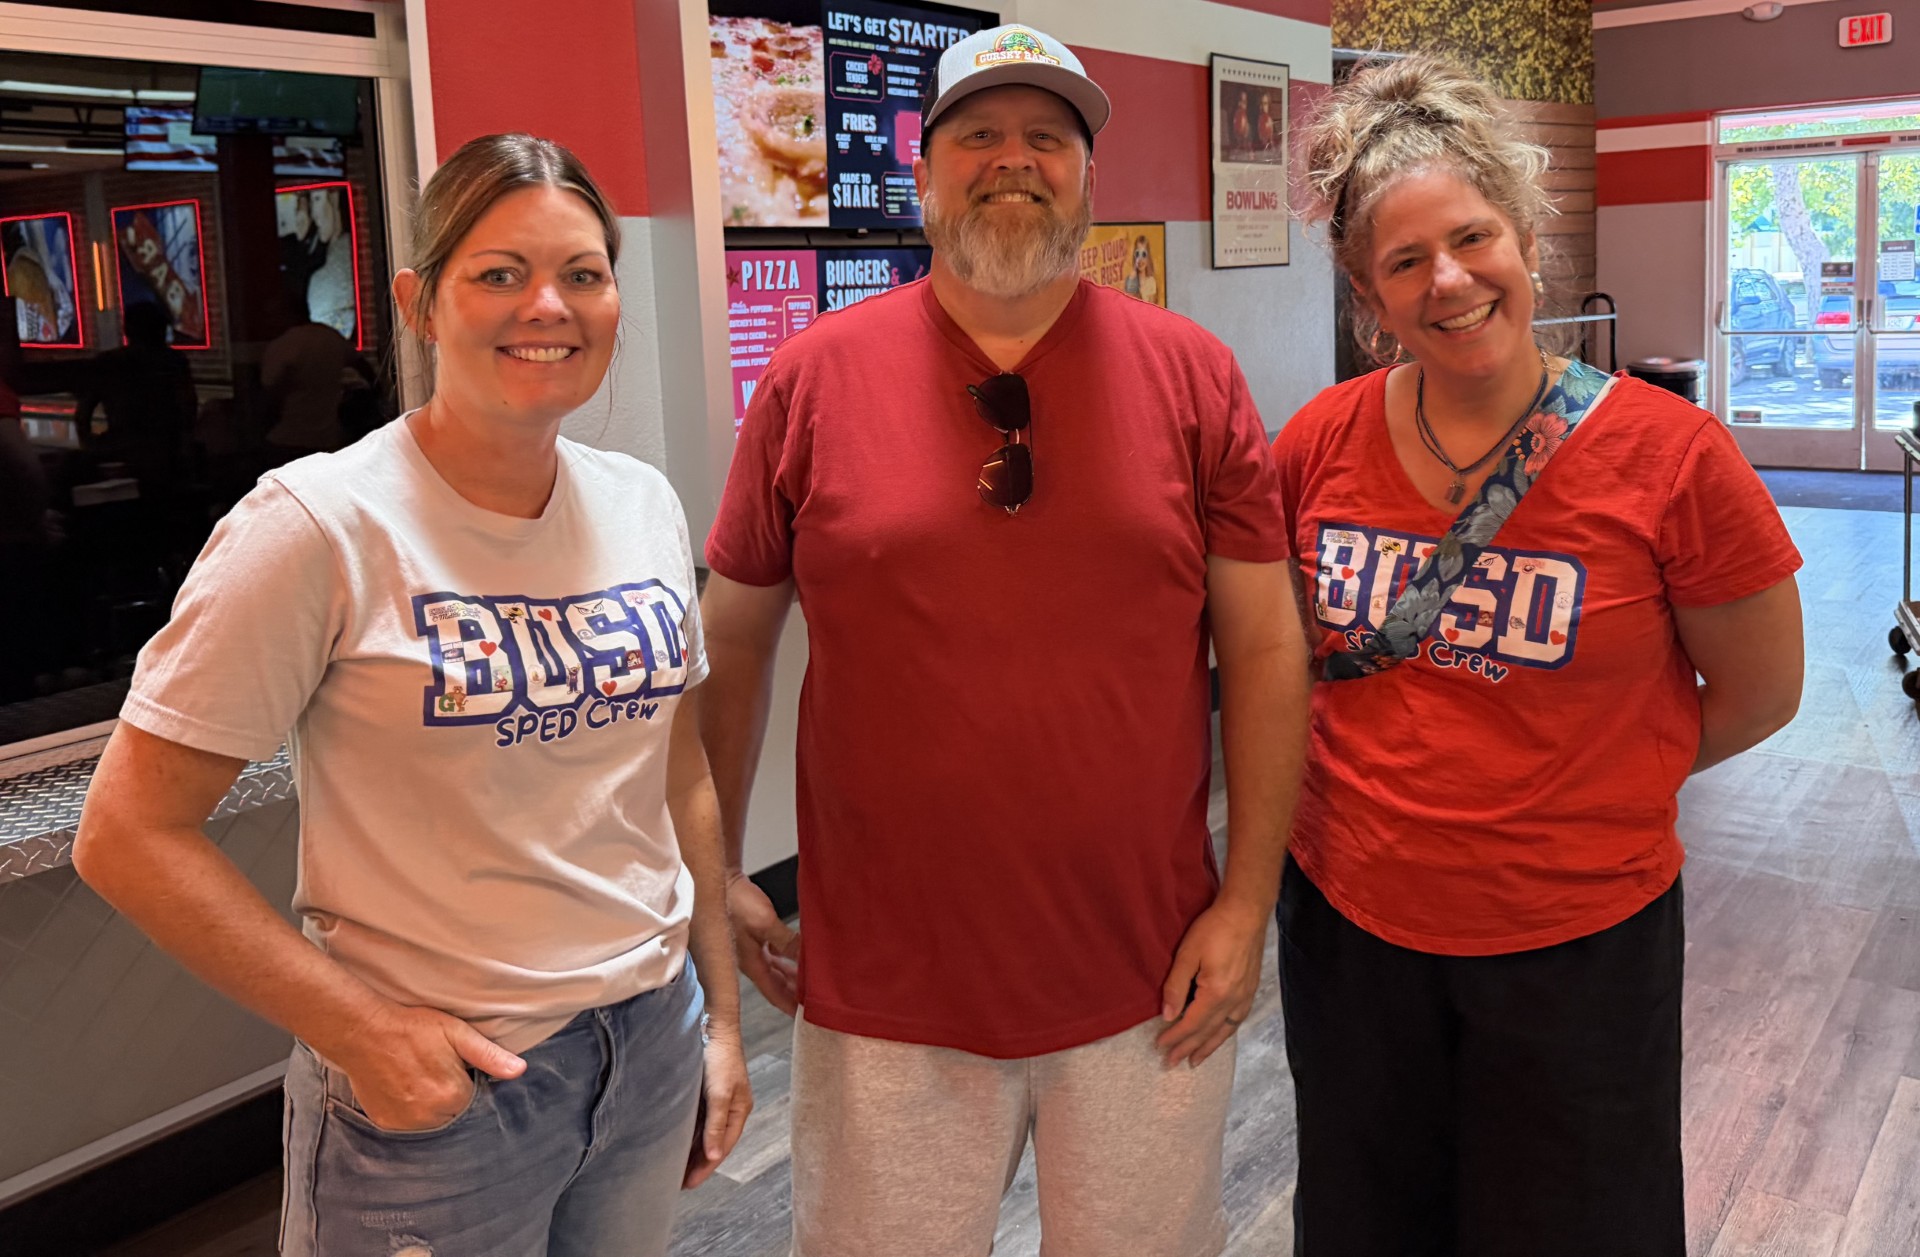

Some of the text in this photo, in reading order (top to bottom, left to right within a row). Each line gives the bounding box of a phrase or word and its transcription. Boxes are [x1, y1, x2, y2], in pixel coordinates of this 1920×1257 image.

[828, 11, 862, 33] LET'S
[864, 17, 887, 37] GET
[1847, 15, 1885, 44] EXIT
[980, 50, 1021, 63] GURSKY
[842, 112, 877, 133] FRIES
[840, 172, 861, 184] MADE
[861, 173, 872, 185] TO
[832, 183, 880, 208] SHARE
[1226, 190, 1278, 210] BOWLING
[1078, 237, 1127, 272] EEP YOUR
[741, 259, 800, 291] PIZZA
[825, 259, 900, 287] BURGERS &
[788, 301, 811, 311] TOPPINGS
[411, 578, 690, 727] BUSD
[1427, 640, 1509, 684] Crew
[438, 695, 456, 714] G
[495, 698, 660, 748] SPED Crew
